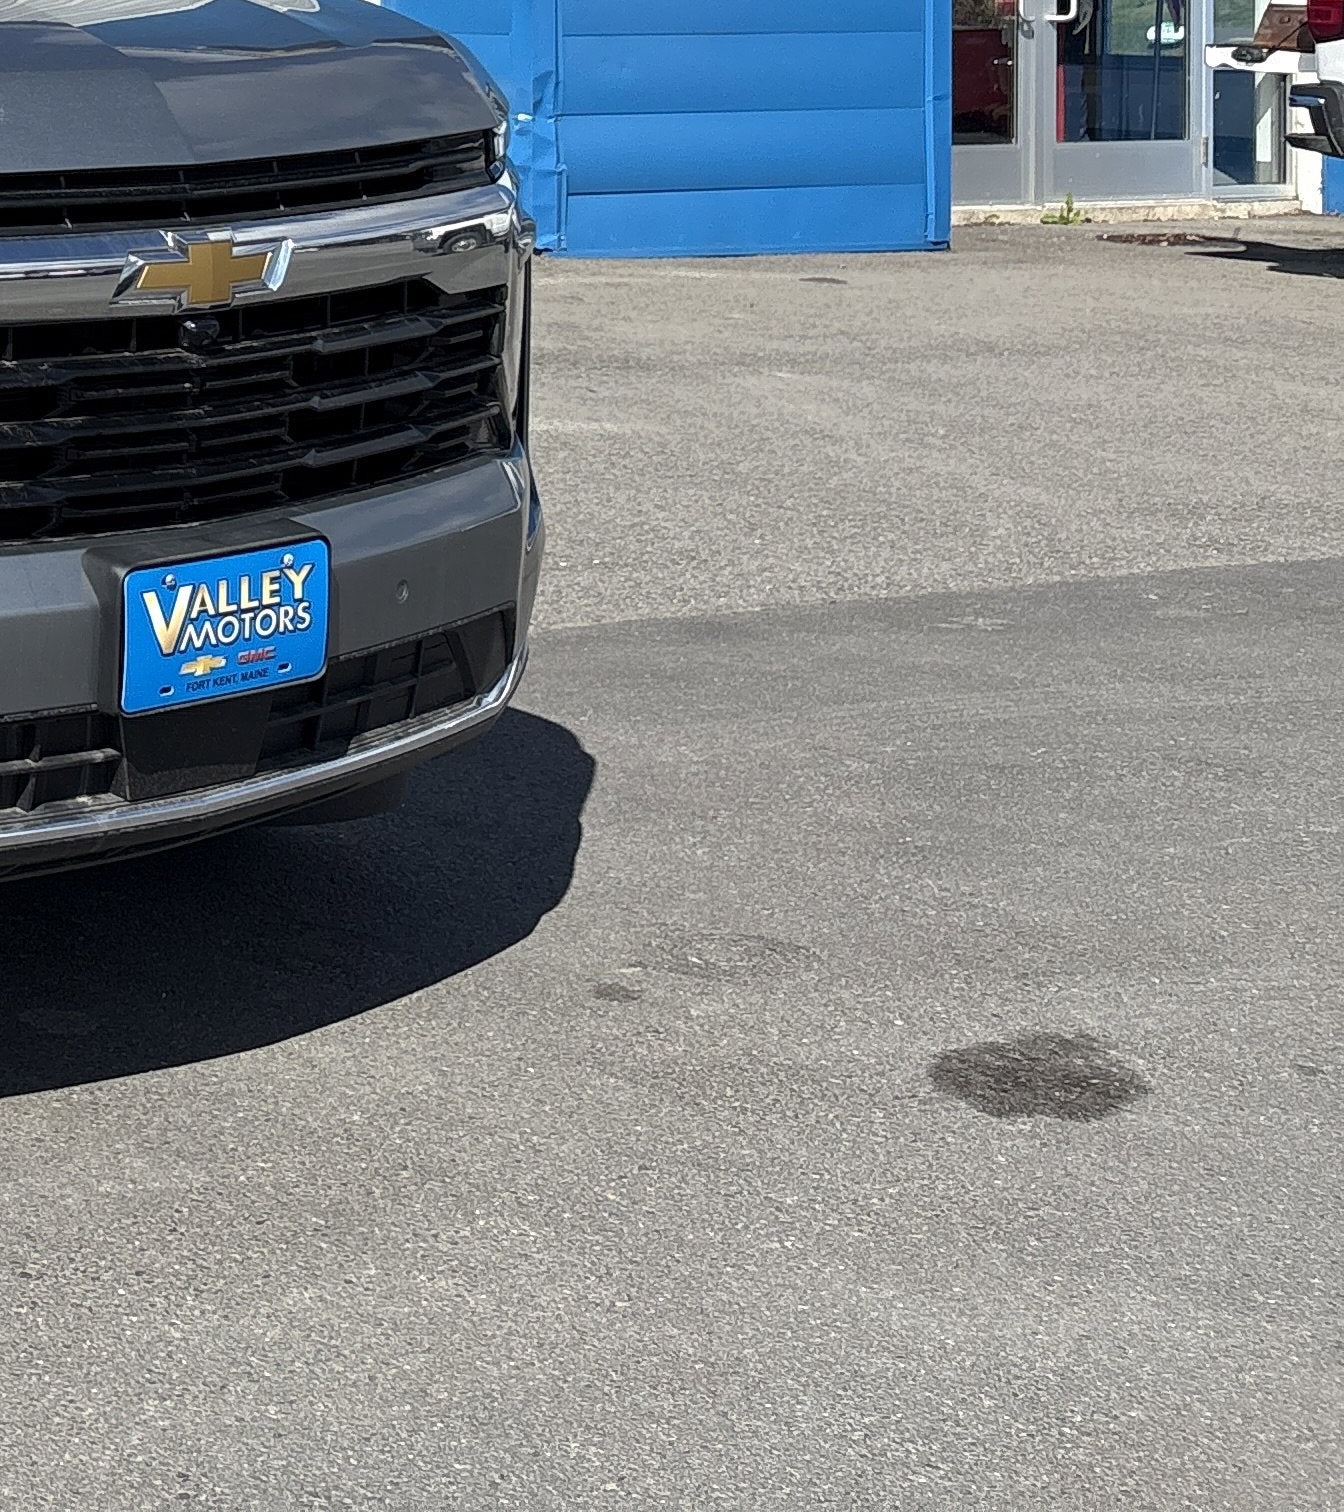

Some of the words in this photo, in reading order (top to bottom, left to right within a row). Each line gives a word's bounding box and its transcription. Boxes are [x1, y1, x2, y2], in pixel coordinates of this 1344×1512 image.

[141, 563, 315, 657] VALLEY
[178, 600, 312, 653] MOTORS
[236, 645, 276, 665] GMC
[185, 679, 211, 693] FORT
[240, 667, 270, 682] MAINE
